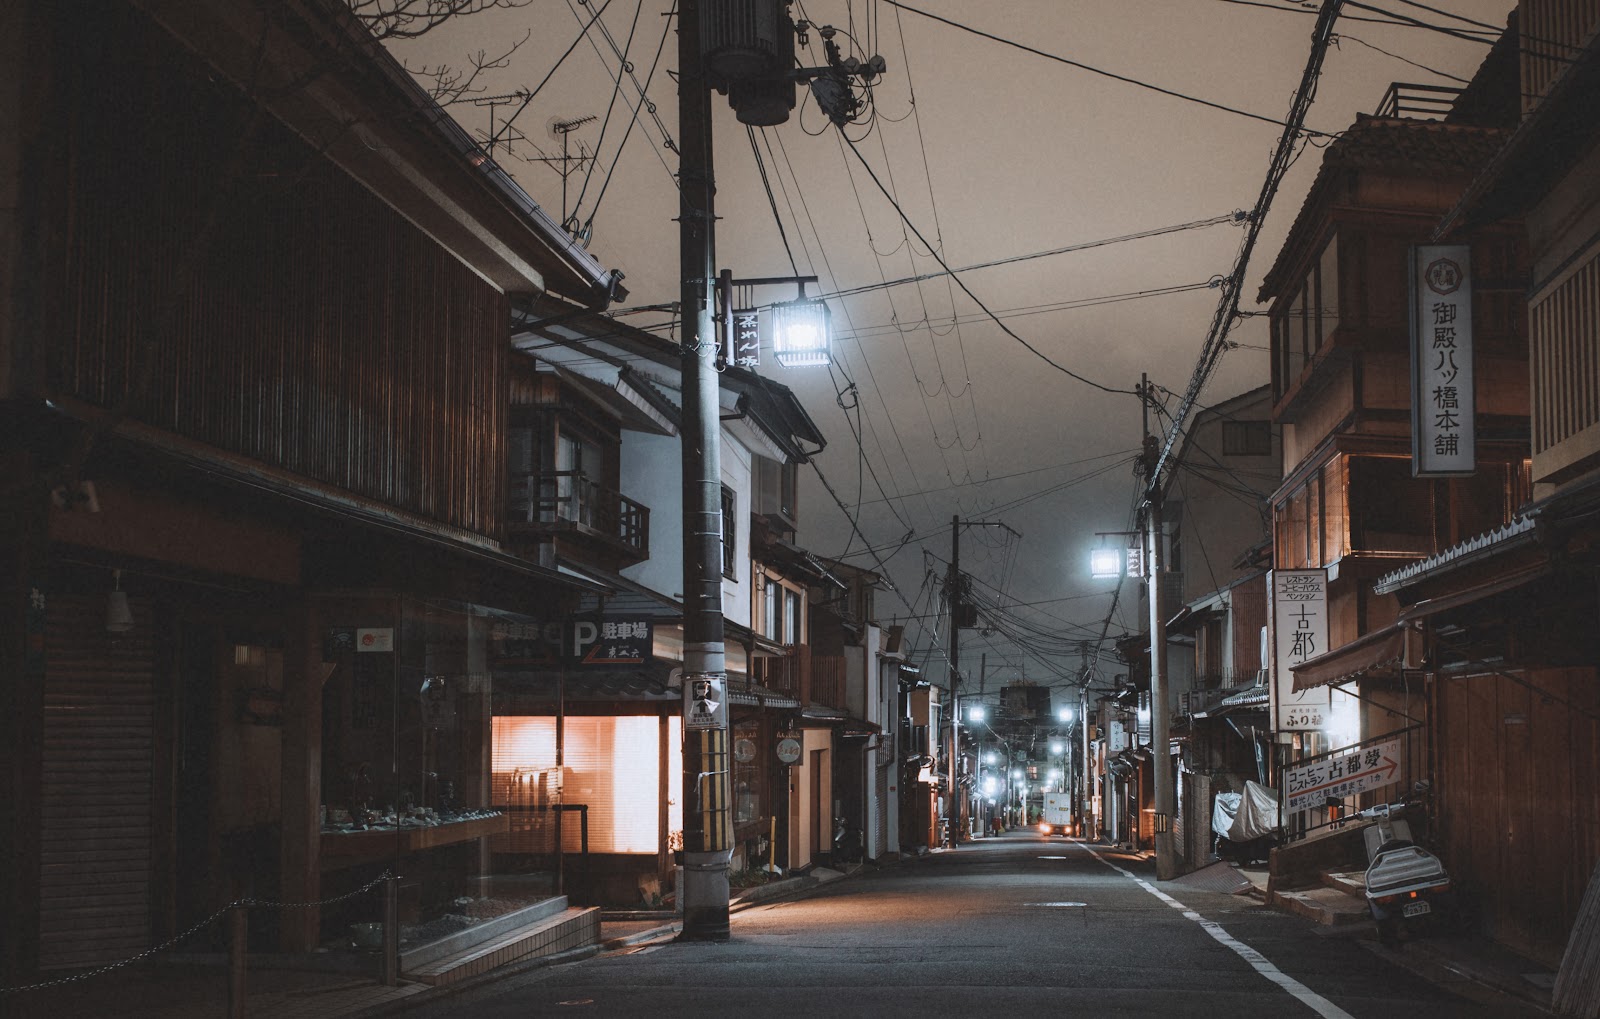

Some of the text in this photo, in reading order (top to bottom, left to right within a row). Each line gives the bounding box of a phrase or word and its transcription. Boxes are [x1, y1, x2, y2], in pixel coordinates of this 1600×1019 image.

[738, 315, 759, 367] 茶わん坂
[1281, 584, 1321, 592] コーヒーハウス
[1286, 576, 1316, 584] レストラン
[574, 621, 598, 657] P
[600, 621, 649, 640] 駐車場
[1327, 748, 1381, 780] 古都夢
[1289, 766, 1324, 783] コーヒー
[1289, 776, 1325, 792] レストラン
[1289, 779, 1364, 808] 観光バス駐車場まで
